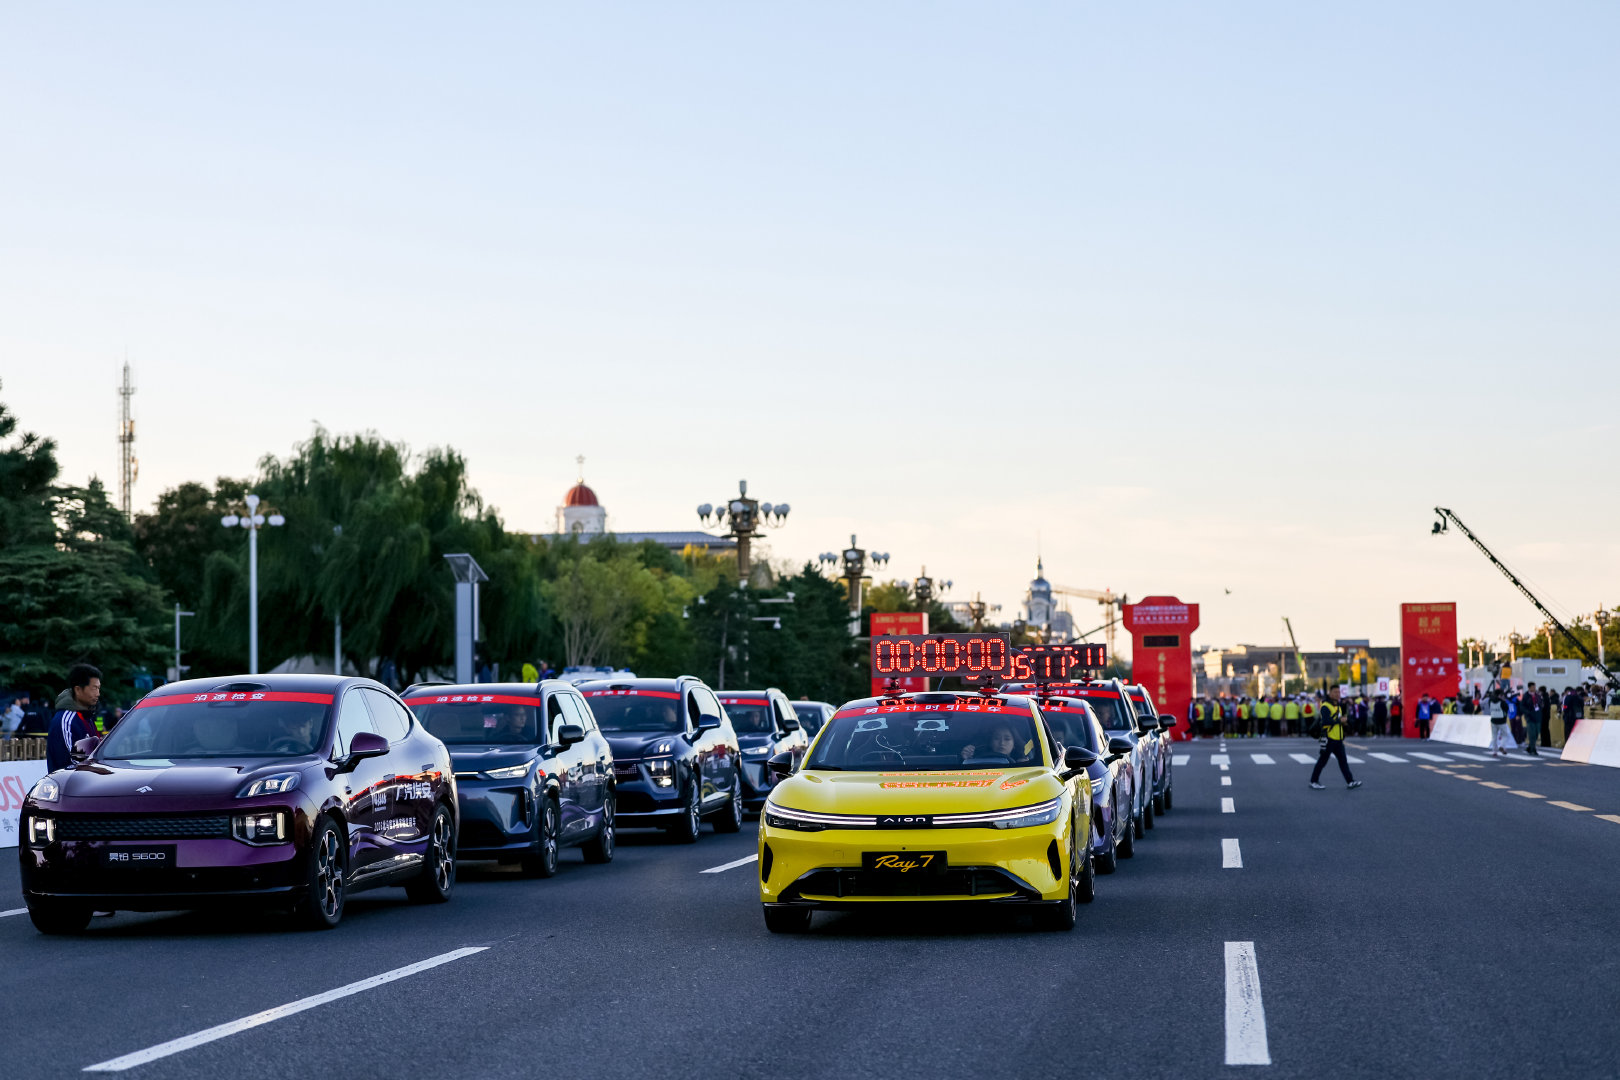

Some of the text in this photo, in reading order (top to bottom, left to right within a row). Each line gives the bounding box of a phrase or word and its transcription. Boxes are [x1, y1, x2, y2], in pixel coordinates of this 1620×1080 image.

[876, 638, 1005, 673] 00:00:00
[193, 692, 266, 702] 沿途检查
[864, 704, 1002, 715] 男子计时引导车
[132, 852, 166, 860] S600
[875, 854, 935, 873] Ray 7
